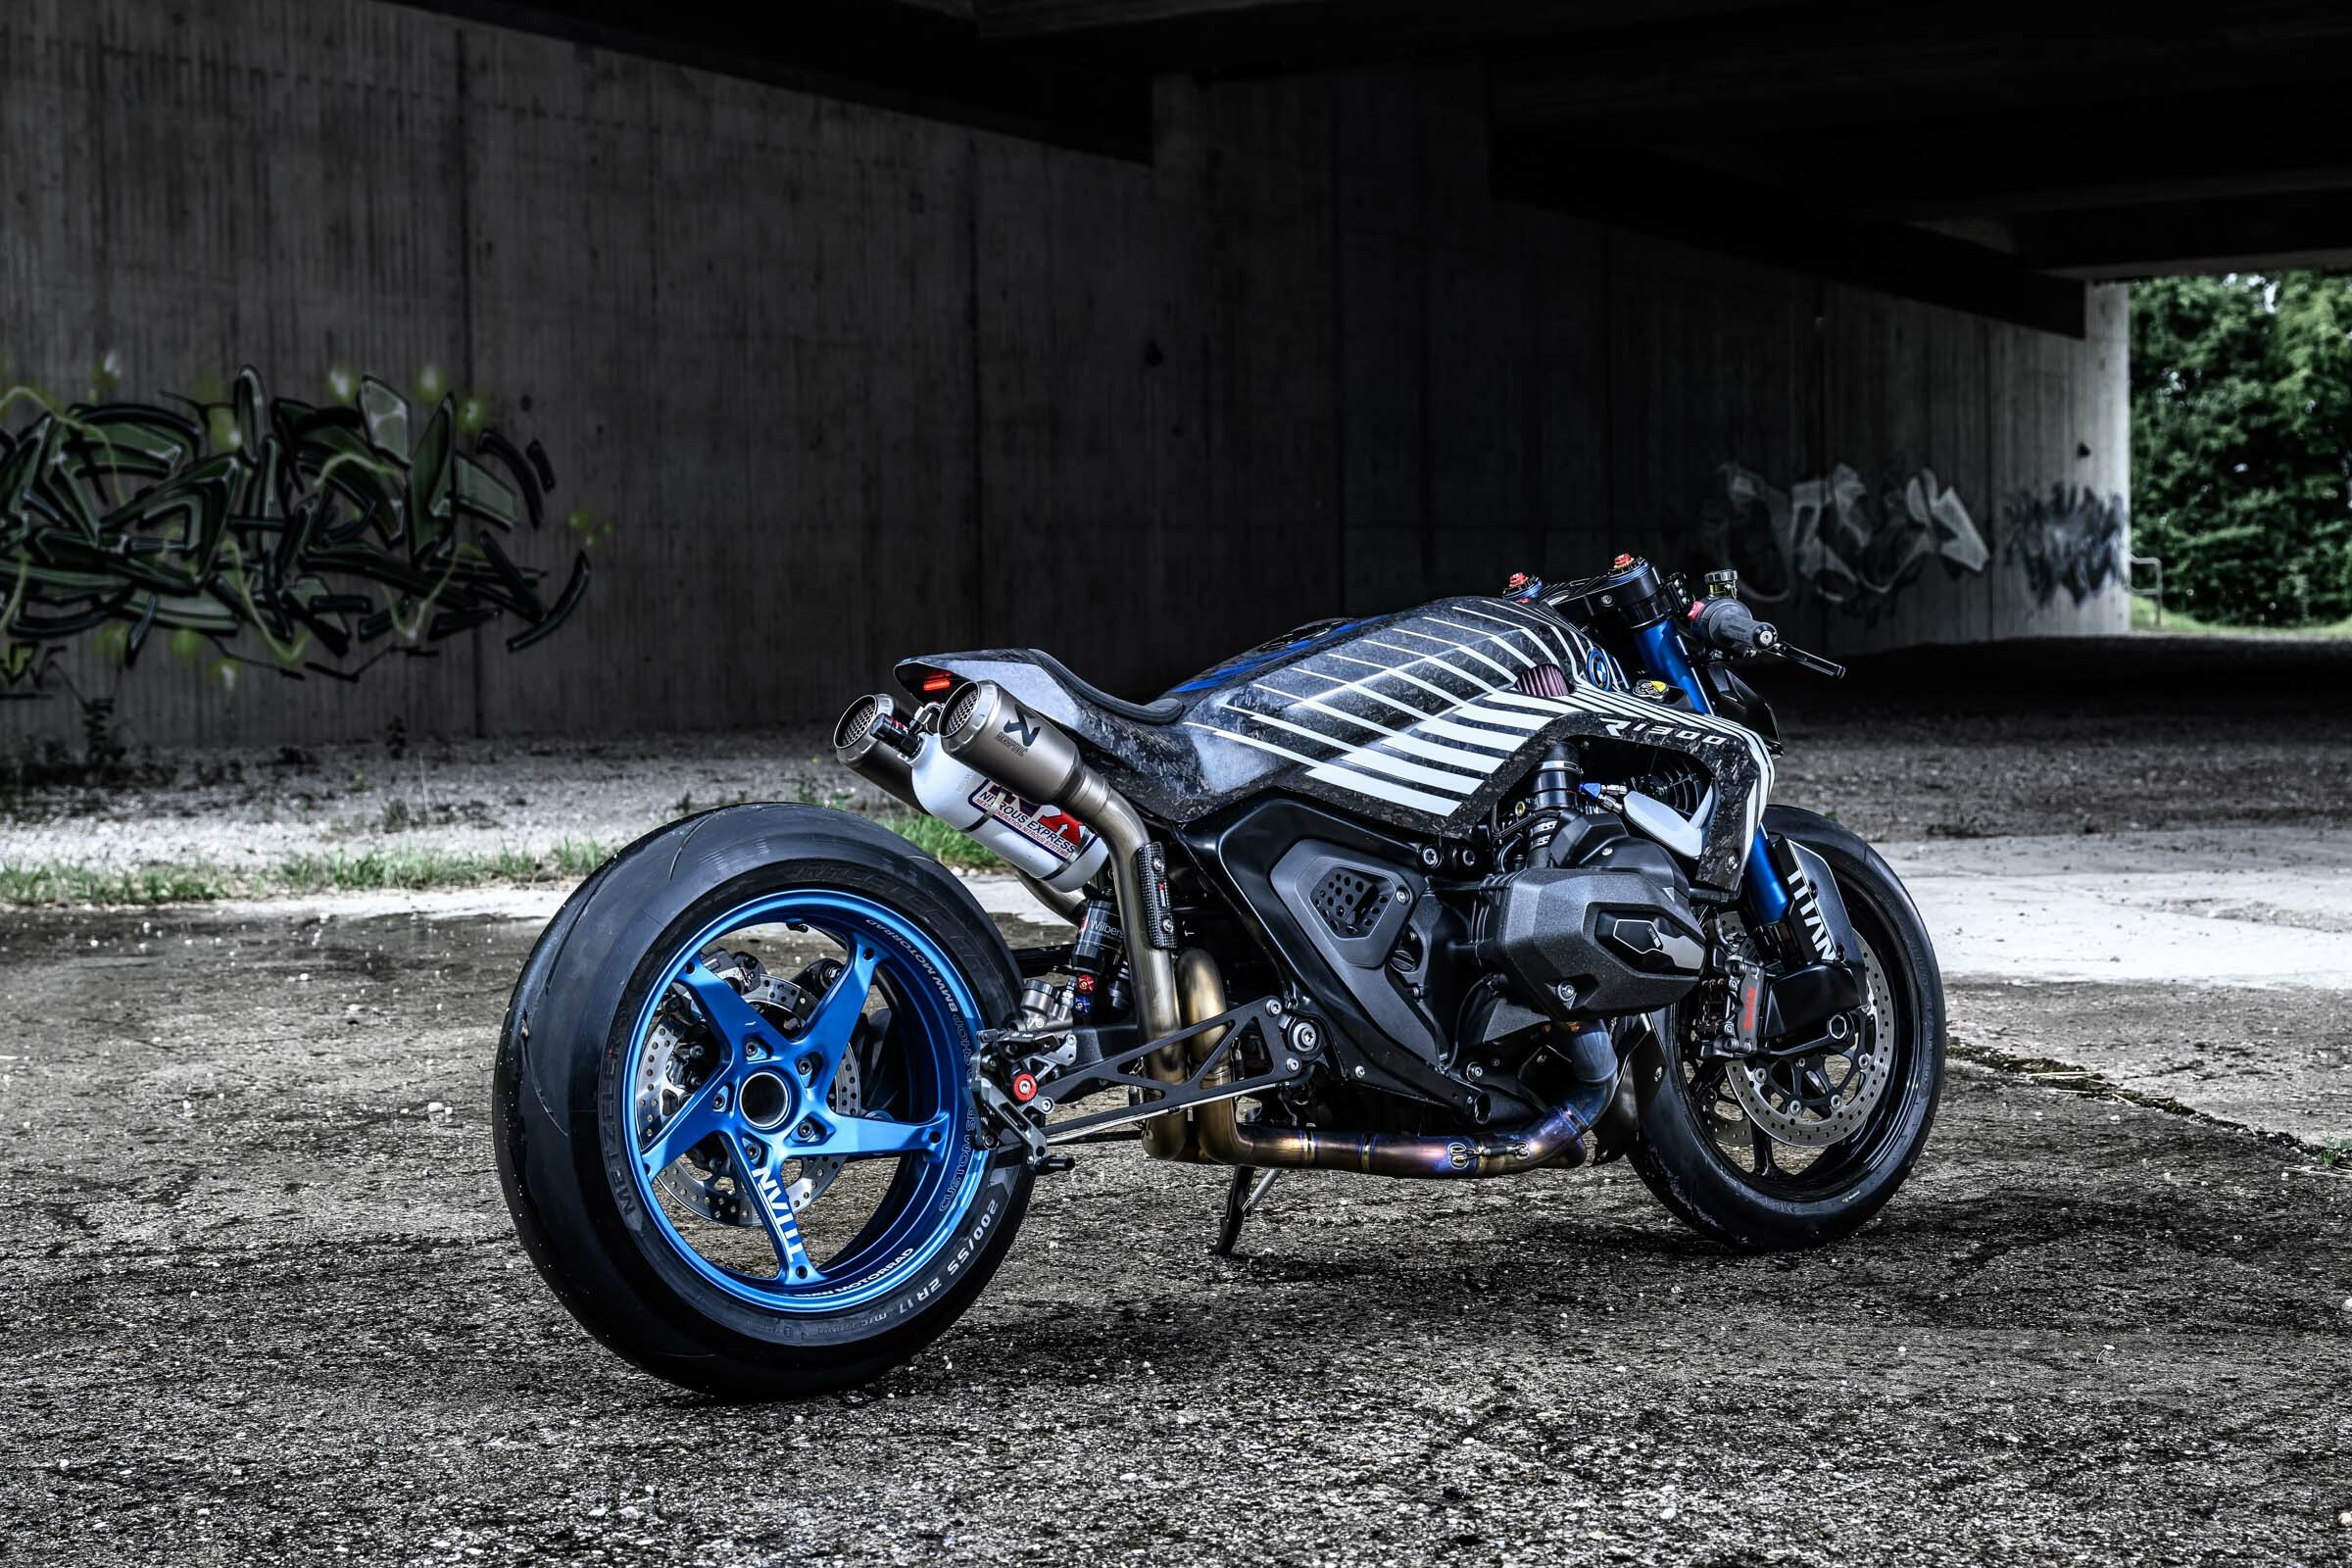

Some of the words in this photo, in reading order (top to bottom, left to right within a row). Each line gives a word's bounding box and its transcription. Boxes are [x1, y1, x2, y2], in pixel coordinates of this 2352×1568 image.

[1022, 826, 1045, 843] NITROUS
[1045, 840, 1068, 858] SYSTEMS
[1027, 820, 1077, 854] EXPRESS
[865, 919, 937, 975] MOTORRAD
[934, 976, 958, 1012] BMW
[1743, 987, 1756, 1031] BMW
[939, 1137, 973, 1212] CUSTOM
[751, 1166, 804, 1262] TITAN
[947, 1199, 999, 1276] 200/55
[834, 1247, 914, 1294] MOTORRAD
